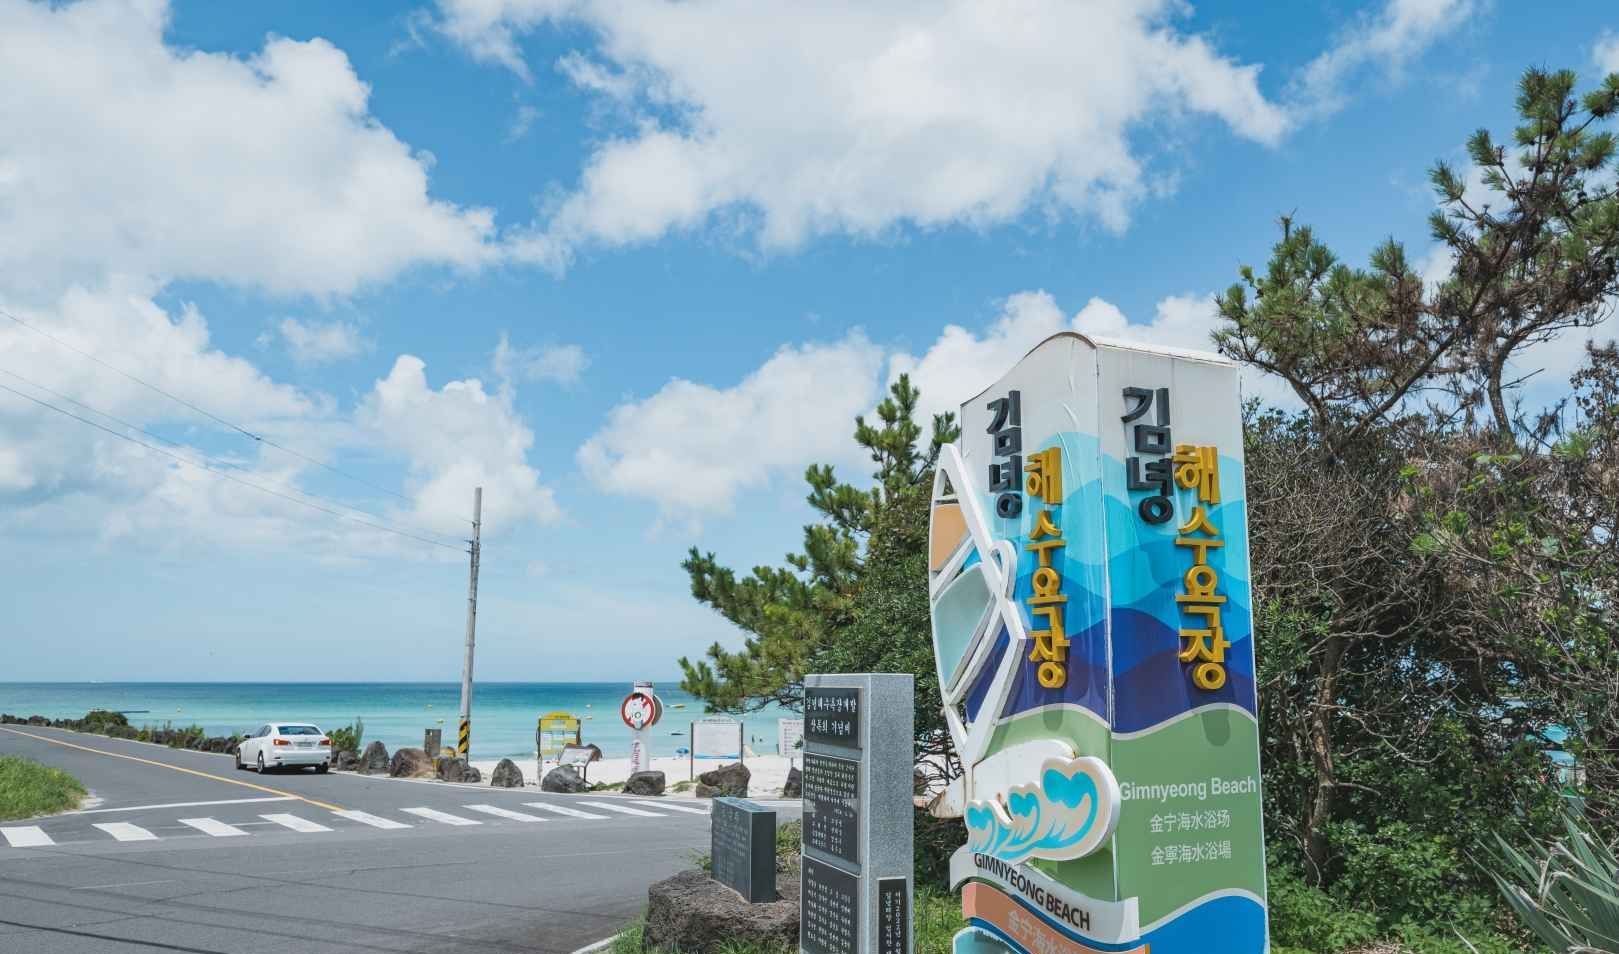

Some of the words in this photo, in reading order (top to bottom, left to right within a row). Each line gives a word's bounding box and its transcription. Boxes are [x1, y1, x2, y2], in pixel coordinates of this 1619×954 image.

[986, 390, 1023, 519] 김녕
[1120, 386, 1174, 525] 김녕
[1024, 446, 1071, 689] 해수욕장
[1172, 444, 1231, 690] 해수욕장
[1119, 782, 1207, 802] Gimnyeong
[1211, 776, 1257, 795] Beach
[1150, 809, 1232, 833] 金宁海水浴场
[974, 852, 1045, 906] GIMNYEONG
[1045, 893, 1090, 931] BEACH
